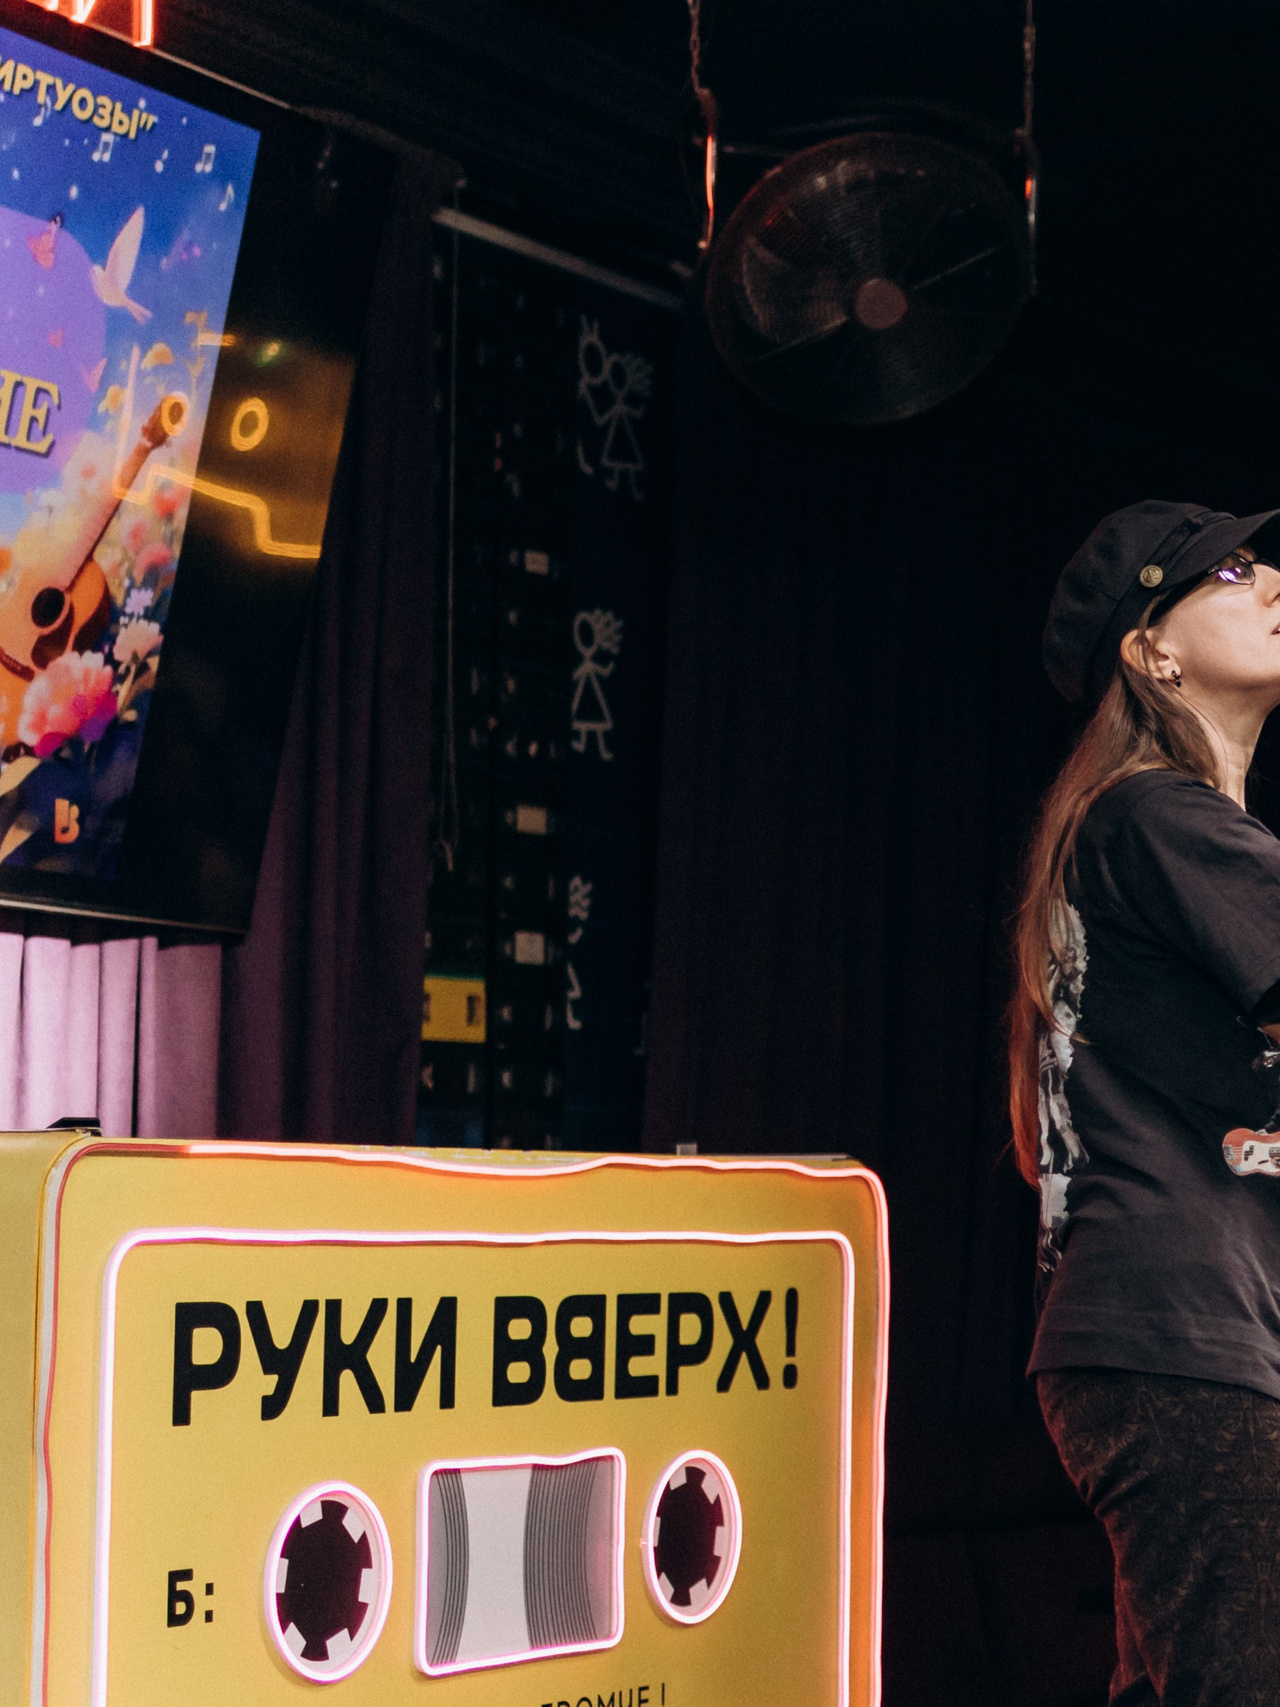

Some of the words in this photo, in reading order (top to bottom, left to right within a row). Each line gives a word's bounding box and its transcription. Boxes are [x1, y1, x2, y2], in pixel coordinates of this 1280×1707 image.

[172, 1296, 458, 1427] РУКИ
[492, 1287, 799, 1407] ВВЕРХ!
[166, 1568, 215, 1628] Б:
